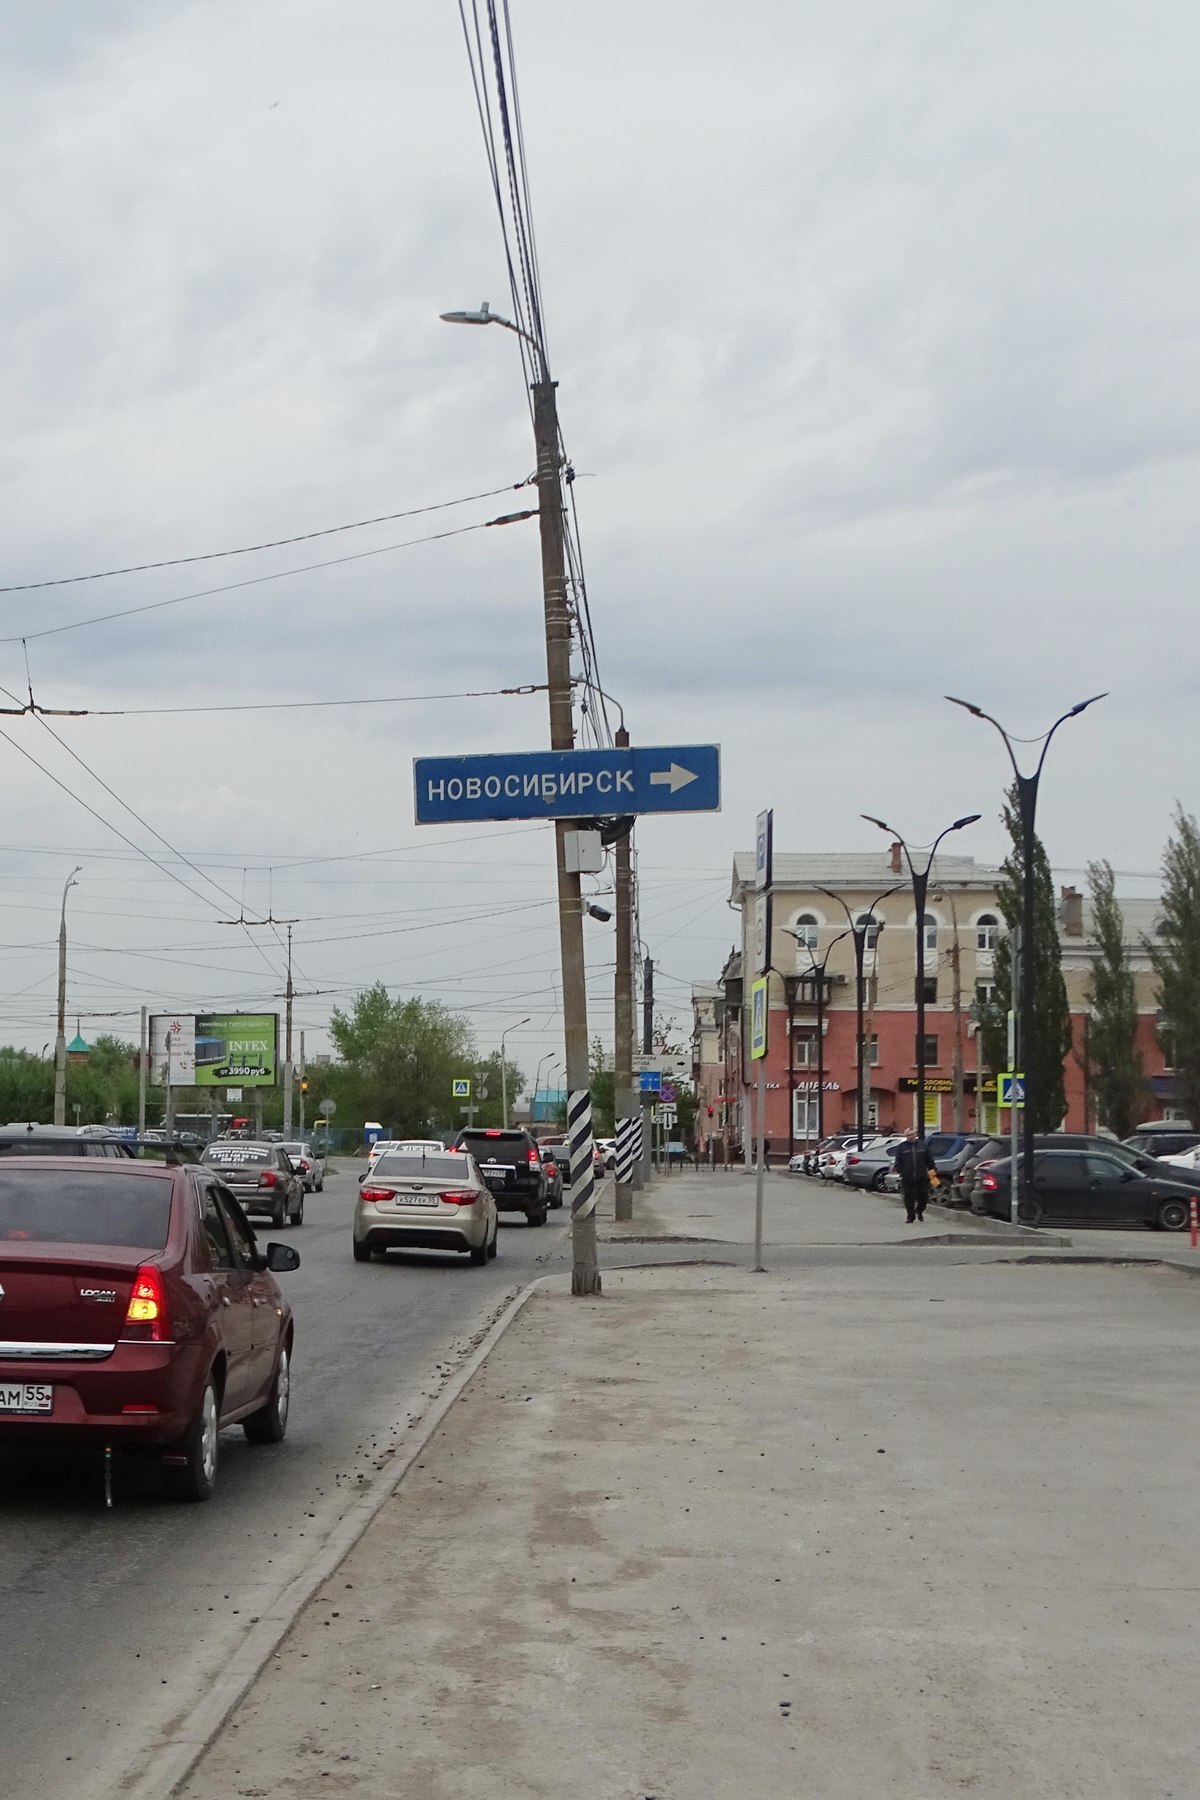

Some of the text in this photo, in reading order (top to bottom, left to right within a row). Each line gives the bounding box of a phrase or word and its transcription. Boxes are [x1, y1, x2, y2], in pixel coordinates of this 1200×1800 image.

[428, 770, 634, 802] НОВОСИБИРСК
[229, 1040, 268, 1051] INTEX
[228, 1067, 250, 1075] 3990
[251, 1067, 265, 1076] руб
[80, 1289, 116, 1297] LOGAN
